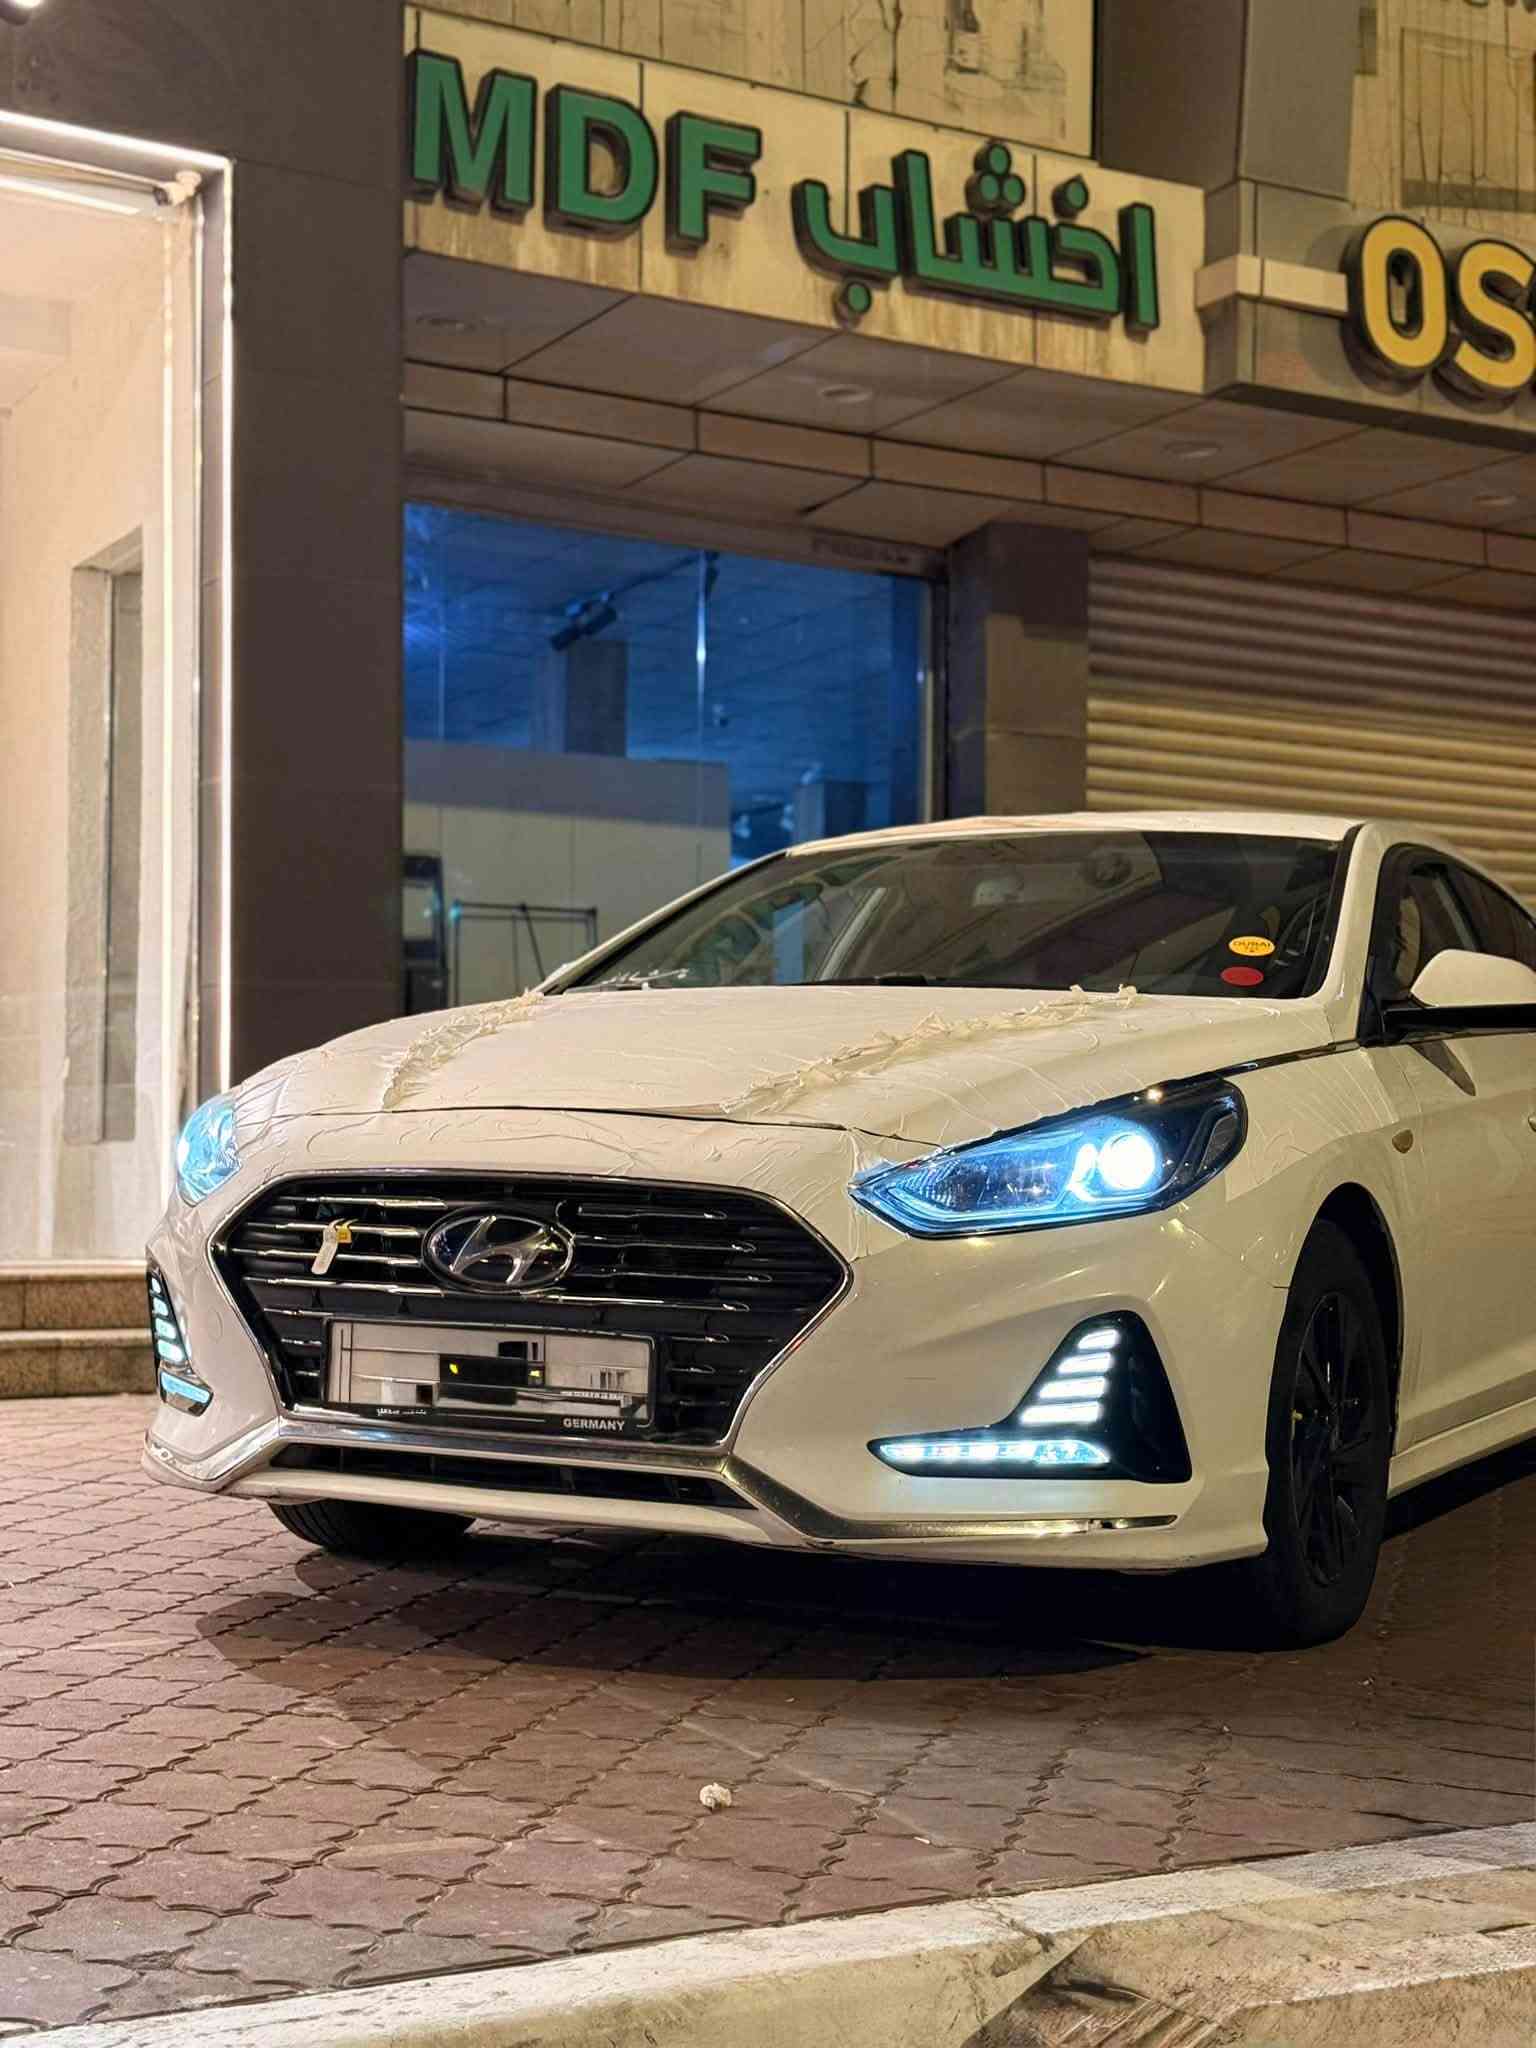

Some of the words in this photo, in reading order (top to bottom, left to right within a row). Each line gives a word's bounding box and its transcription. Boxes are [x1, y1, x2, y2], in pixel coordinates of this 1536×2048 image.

[407, 49, 761, 246] MDF
[796, 142, 1159, 329] اخشاب
[563, 1417, 625, 1431] GERMANY
